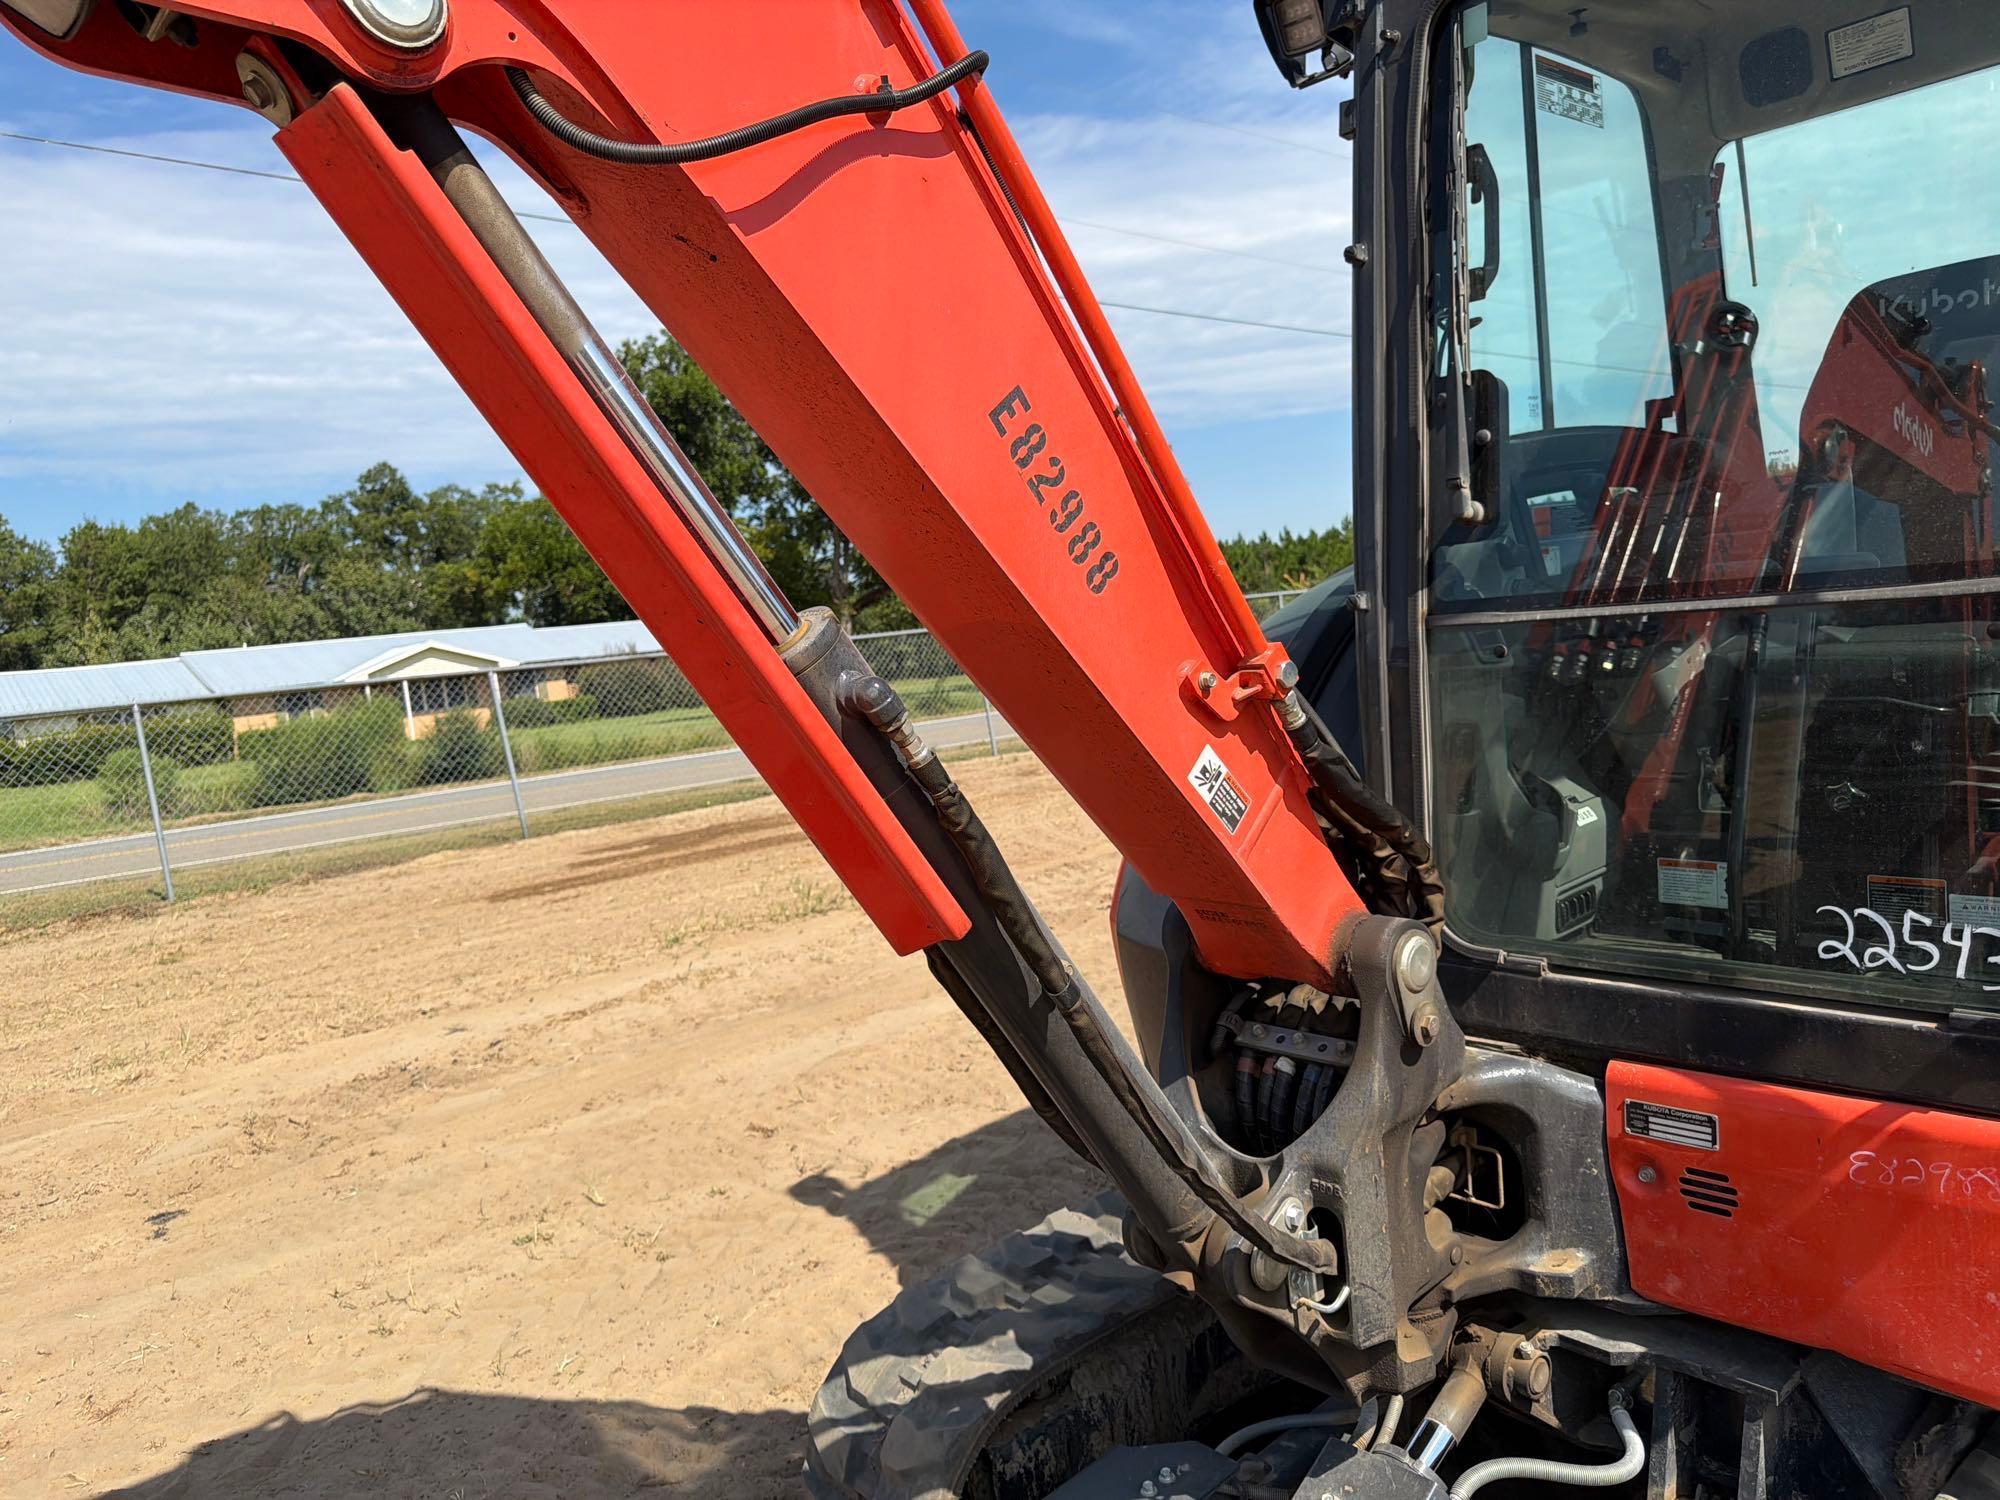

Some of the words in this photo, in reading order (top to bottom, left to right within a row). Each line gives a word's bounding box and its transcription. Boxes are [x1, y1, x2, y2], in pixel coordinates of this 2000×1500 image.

[1879, 278, 2000, 327] Kubot
[988, 385, 1119, 594] E82988
[1643, 1104, 1670, 1115] KUBOTA
[1670, 1109, 1708, 1121] Corporation
